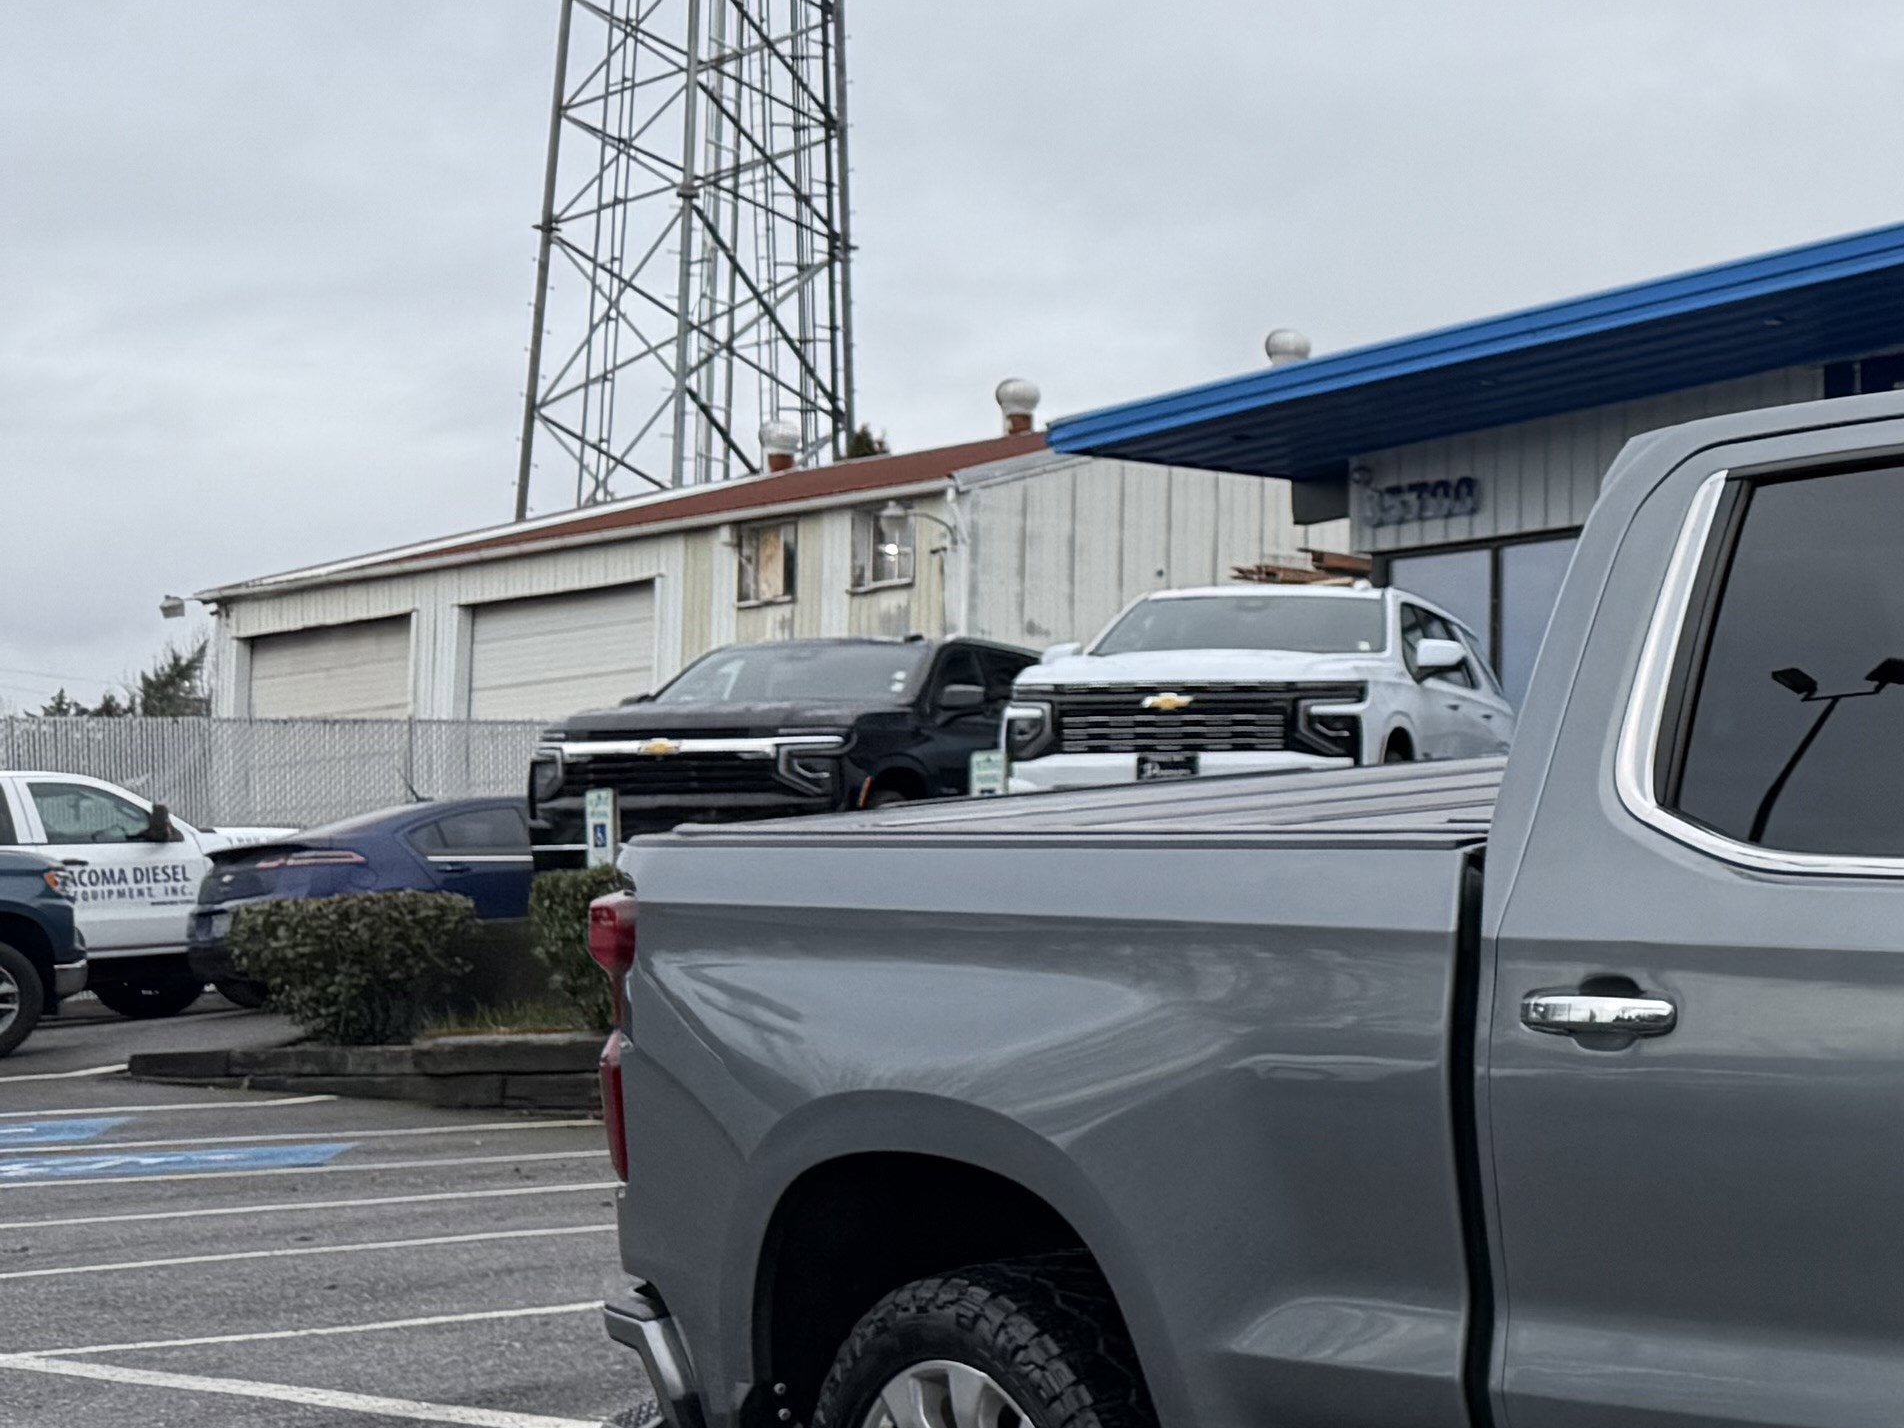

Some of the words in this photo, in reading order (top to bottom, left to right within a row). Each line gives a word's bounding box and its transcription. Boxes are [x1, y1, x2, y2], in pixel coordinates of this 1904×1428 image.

[66, 867, 128, 887] ACOMA
[133, 864, 191, 884] DIESEL
[71, 887, 153, 903] QUIPMENT
[164, 884, 193, 898] INC.
